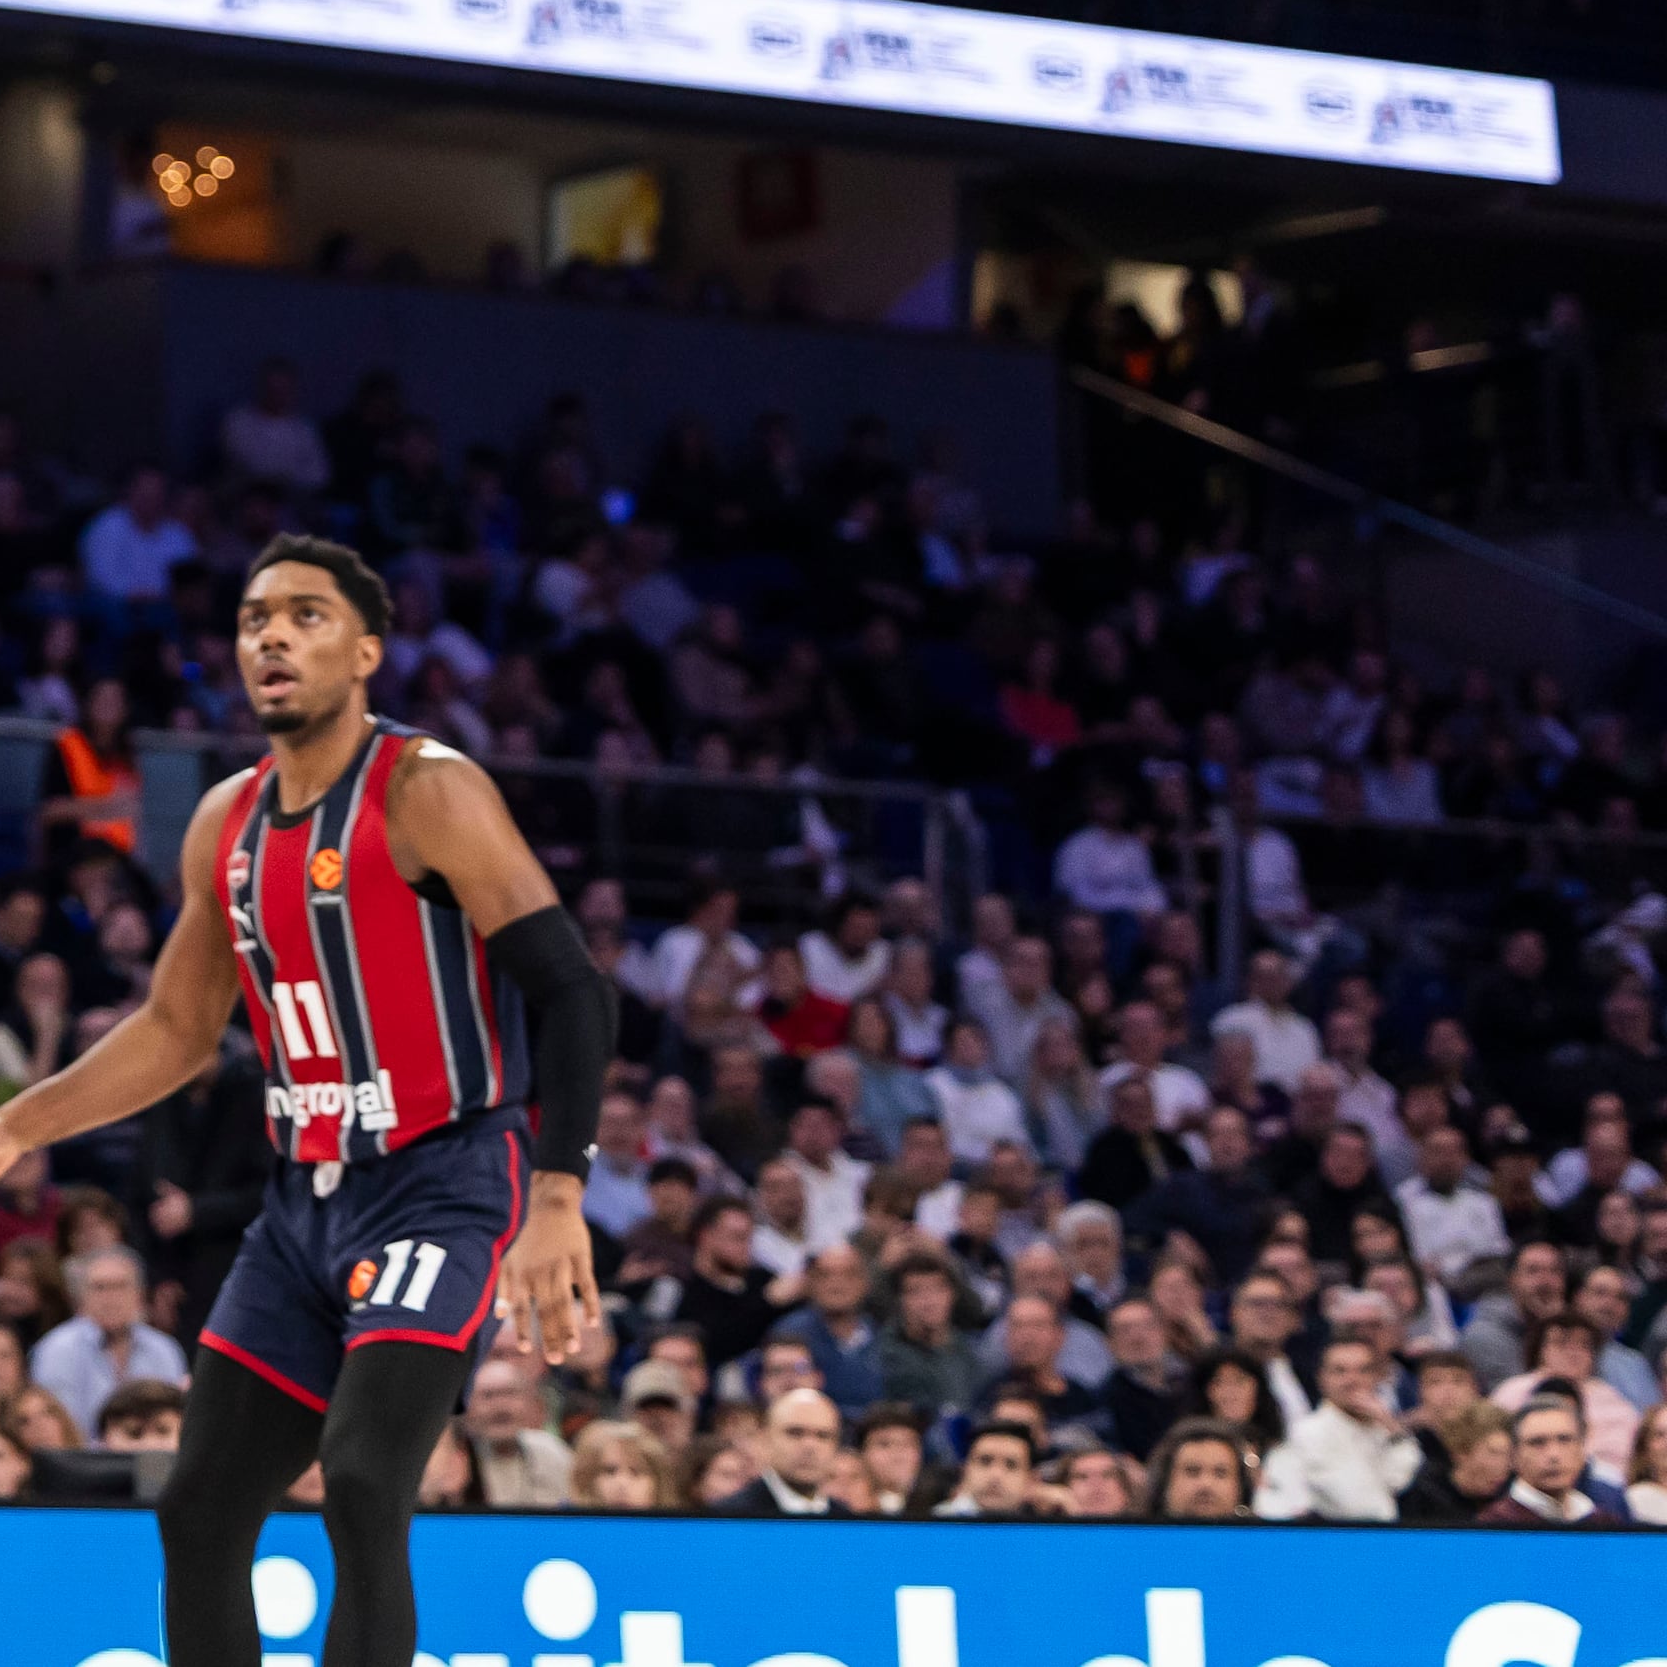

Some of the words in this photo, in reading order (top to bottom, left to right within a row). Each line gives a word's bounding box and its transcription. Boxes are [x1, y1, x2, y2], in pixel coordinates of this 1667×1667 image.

[272, 980, 338, 1061] 11
[266, 1068, 395, 1130] ngroyal
[370, 1237, 448, 1312] 11
